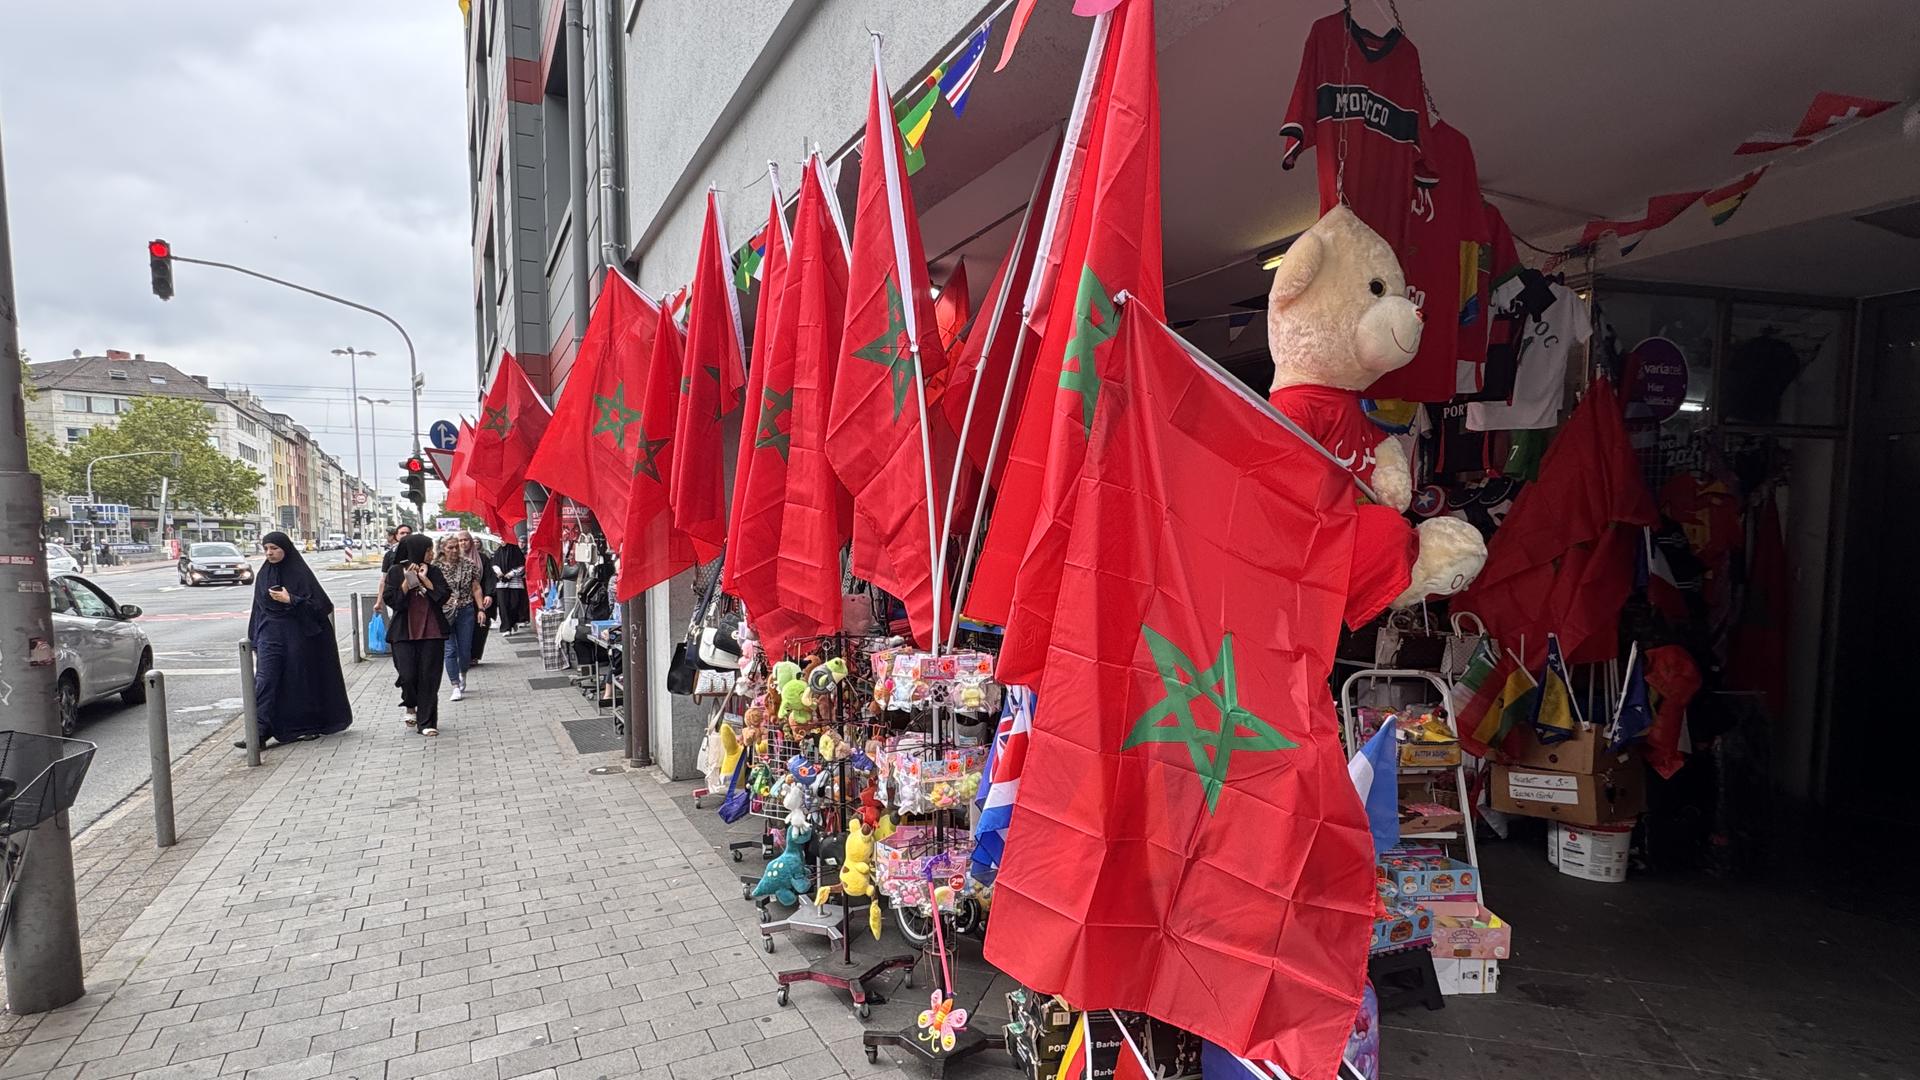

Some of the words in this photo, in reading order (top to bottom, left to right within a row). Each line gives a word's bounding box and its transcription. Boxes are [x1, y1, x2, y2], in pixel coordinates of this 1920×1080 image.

[1336, 92, 1390, 127] MORCCO
[1443, 403, 1468, 419] POR
[1509, 445, 1519, 461] 7
[1048, 1043, 1070, 1053] POR
